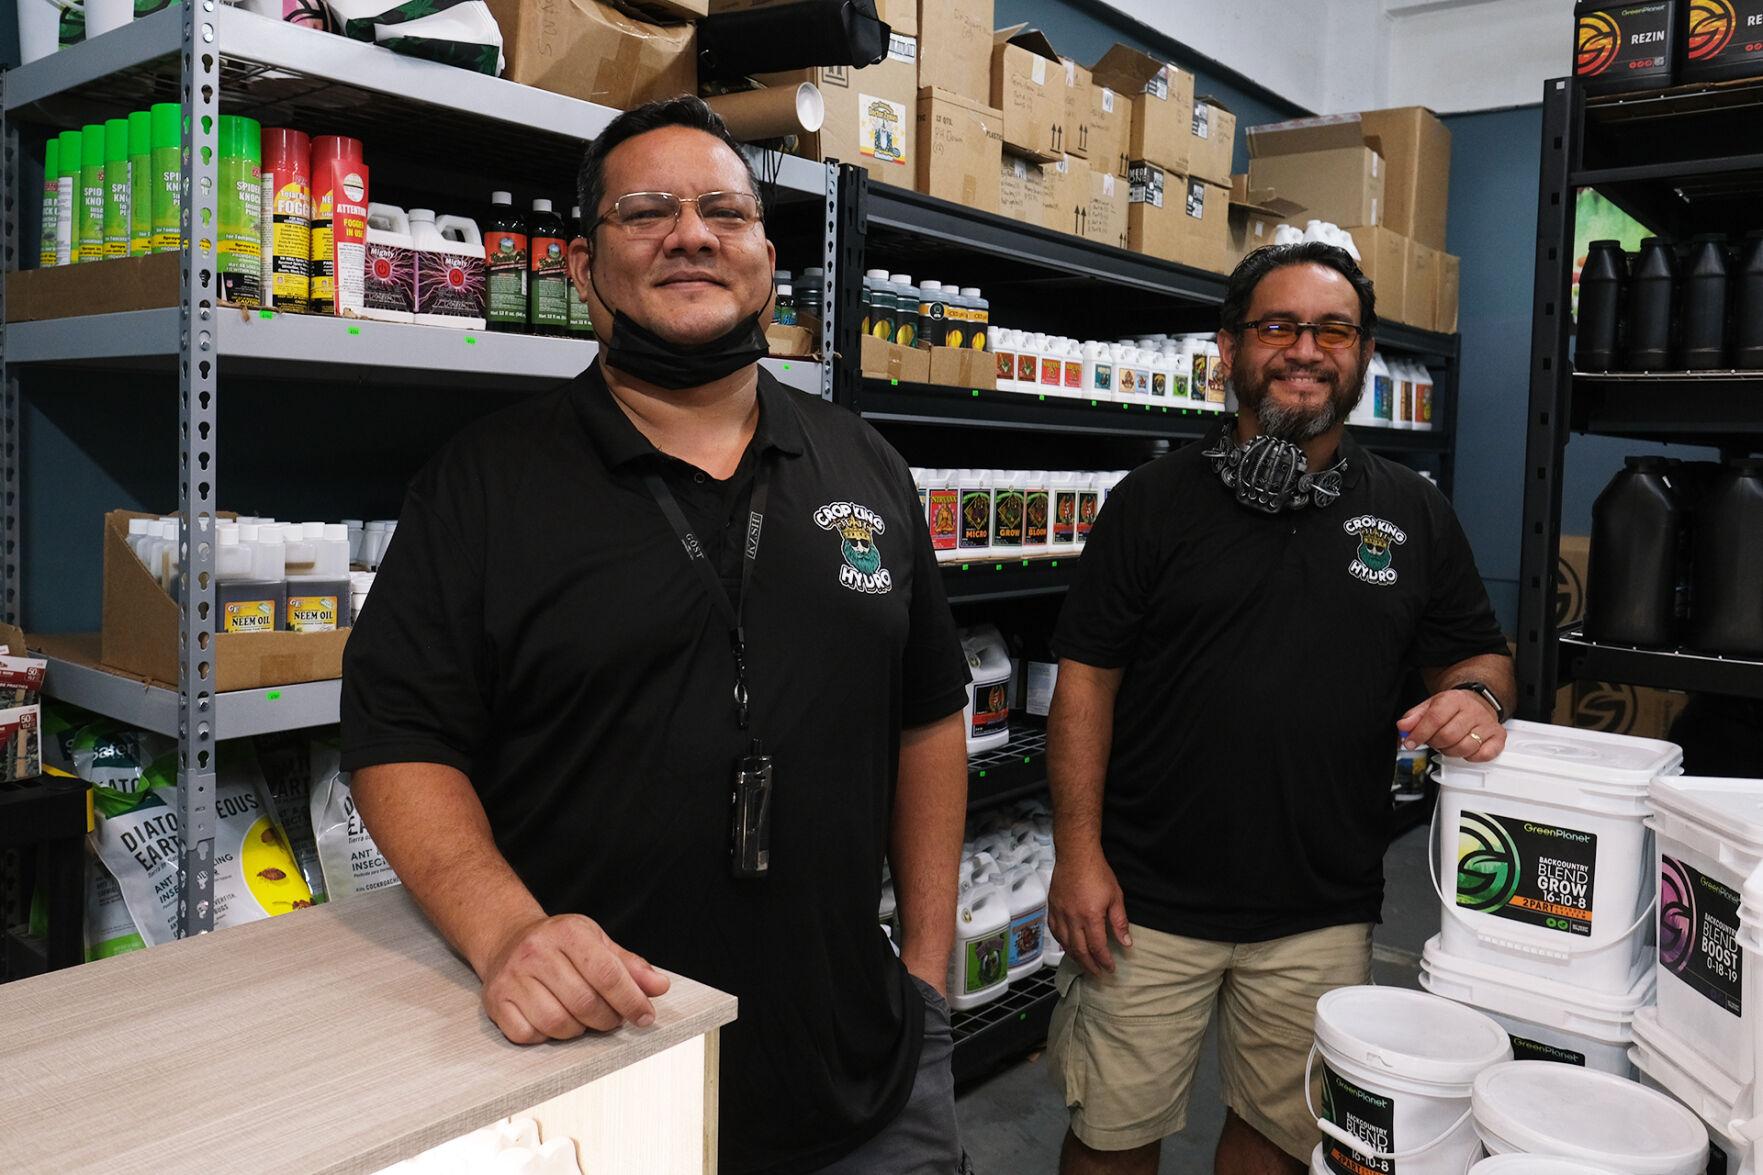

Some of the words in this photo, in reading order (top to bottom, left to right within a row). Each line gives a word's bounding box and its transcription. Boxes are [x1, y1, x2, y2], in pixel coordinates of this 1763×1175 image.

[1621, 4, 1666, 17] GreenPlanet
[1631, 30, 1666, 45] REZIN
[370, 248, 395, 258] Mighty
[446, 257, 467, 268] Mighty
[816, 503, 852, 526] CROP
[852, 505, 883, 531] KING
[1345, 517, 1376, 532] CROP
[1377, 521, 1405, 542] KING
[841, 566, 890, 589] HYDRO
[1350, 562, 1397, 582] HYDRO
[232, 617, 256, 626] NEEM
[258, 616, 270, 625] OIL
[294, 612, 317, 620] NEEM
[320, 611, 333, 619] OIL
[28, 667, 37, 676] 50
[21, 714, 31, 724] 50
[1524, 823, 1591, 843] GreenPlanet
[1538, 864, 1588, 884] BLEND
[1539, 857, 1588, 872] BACKCOUNTRY
[159, 887, 179, 903] INSE
[1537, 876, 1587, 897] GROW
[1523, 899, 1554, 912] 2PART
[1542, 890, 1587, 909] 16-10-8
[1703, 921, 1738, 953] BLEND
[1702, 938, 1738, 970] BOOST
[1706, 957, 1738, 983] 0-18-19
[1514, 1038, 1579, 1062] GreenPlanet
[1336, 1077, 1388, 1108] GreenPlanet
[1346, 1112, 1388, 1135] BACKCOUNTRY
[1346, 1118, 1388, 1147] BLEND
